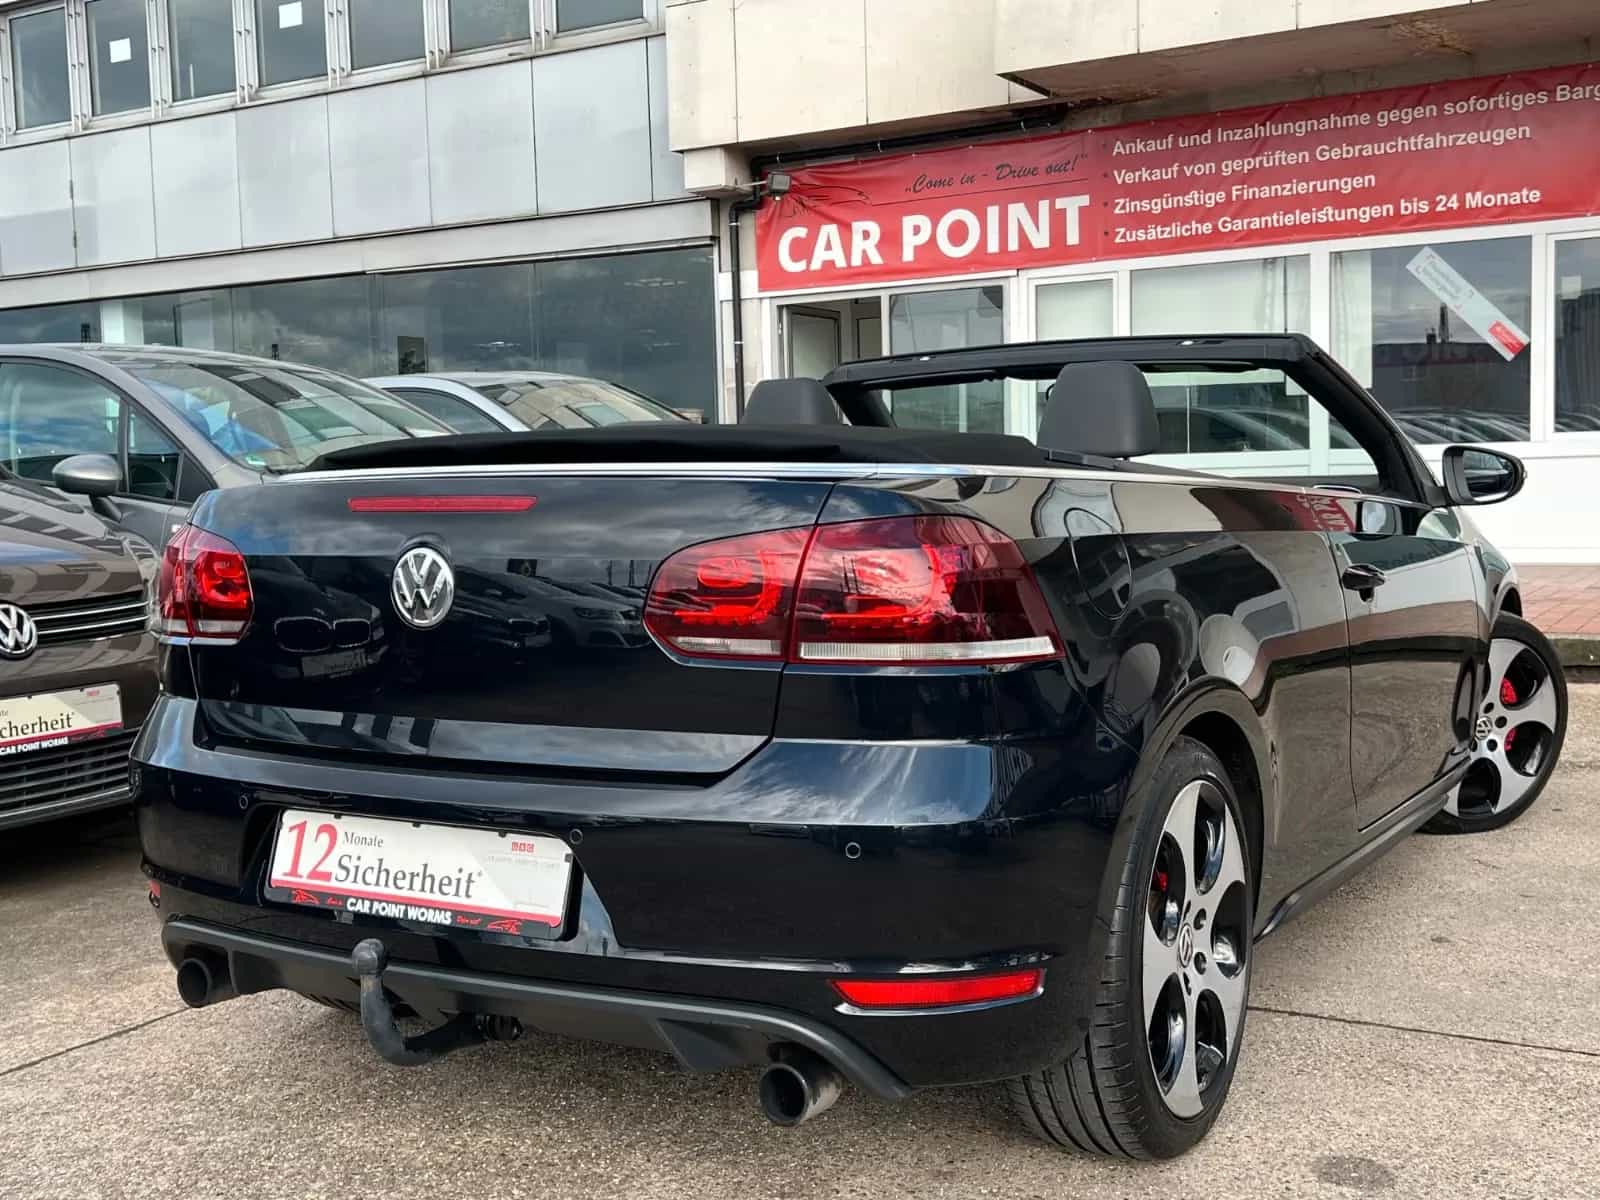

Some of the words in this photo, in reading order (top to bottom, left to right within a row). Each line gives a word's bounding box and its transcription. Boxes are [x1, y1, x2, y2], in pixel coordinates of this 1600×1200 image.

[1112, 134, 1174, 156] Ankauf
[1179, 128, 1211, 148] und
[1217, 113, 1371, 142] Inzahlungnahme
[1376, 104, 1437, 127] gegen
[1443, 91, 1549, 115] sofortiges
[960, 173, 976, 185] in
[995, 163, 1039, 181] Drive
[1113, 163, 1179, 185] Verkauf
[1183, 161, 1216, 177] von
[1221, 151, 1309, 176] geprüften
[1315, 125, 1531, 161] Gebrauchtfahrzeugen
[1114, 189, 1226, 214] Zinsgünstige
[1231, 174, 1376, 201] Finanzierungen
[1114, 220, 1213, 243] Zusätzliche
[1217, 203, 1394, 232] Garantieleistungen
[1400, 197, 1430, 215] bis
[1435, 194, 1459, 212] 24
[1465, 187, 1541, 209] Monate
[777, 220, 884, 273] CAR
[901, 194, 1091, 262] POINT
[282, 819, 338, 883] 12
[342, 831, 384, 848] Monate
[346, 897, 370, 914] CAR
[371, 900, 406, 919] POINT
[407, 905, 452, 926] WORMS
